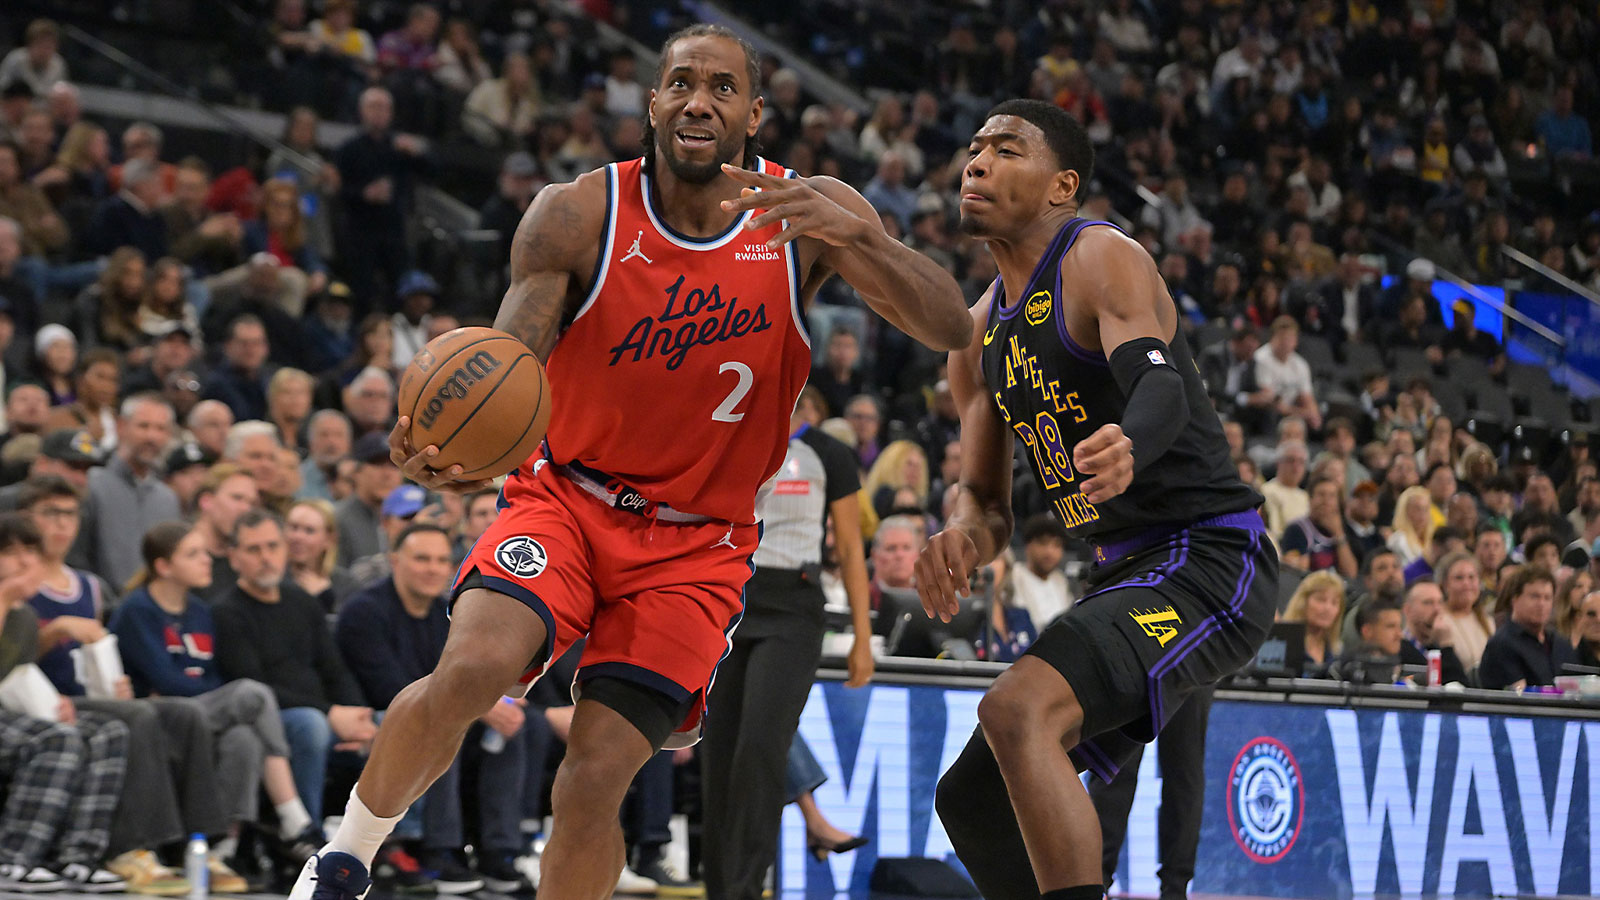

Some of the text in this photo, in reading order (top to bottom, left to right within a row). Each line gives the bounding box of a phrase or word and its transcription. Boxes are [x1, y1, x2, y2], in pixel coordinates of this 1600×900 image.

[735, 252, 780, 260] RWANDA
[743, 244, 769, 252] VISIT
[658, 274, 726, 323] Los
[1028, 299, 1051, 315] bibigo
[608, 303, 772, 371] Angeles
[417, 350, 503, 431] Wilson
[711, 361, 754, 423] 2
[1005, 334, 1088, 423] ANGELES
[1013, 411, 1075, 490] 28
[621, 493, 649, 509] Clip
